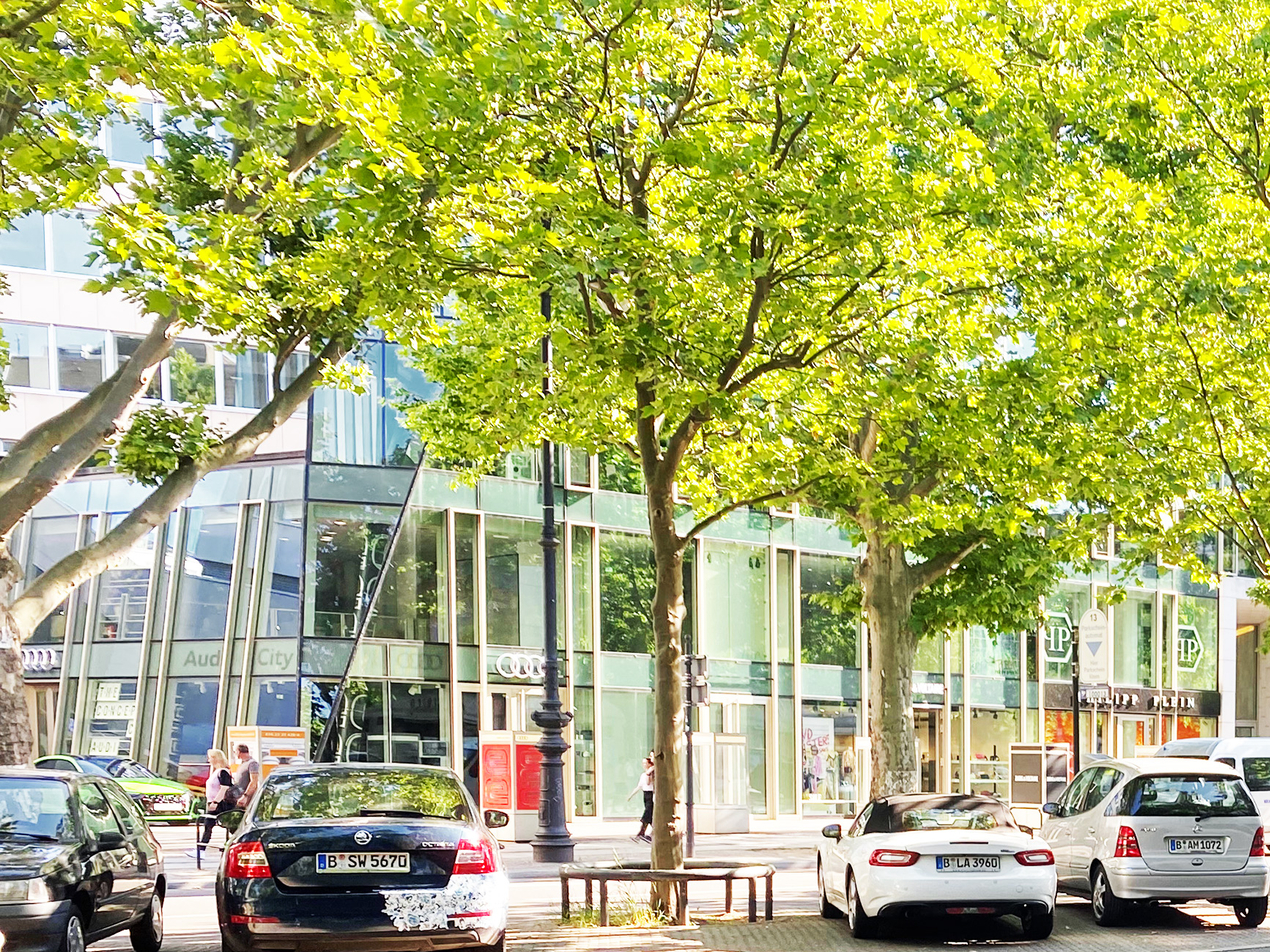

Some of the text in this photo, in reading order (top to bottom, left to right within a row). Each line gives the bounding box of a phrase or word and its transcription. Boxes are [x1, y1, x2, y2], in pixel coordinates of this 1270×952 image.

[1090, 614, 1097, 622] 13
[183, 649, 294, 669] Aud City
[1153, 694, 1195, 708] PLEIN
[1176, 840, 1182, 850] B
[328, 854, 337, 868] B
[348, 854, 367, 868] SW
[370, 854, 407, 868] 5670
[943, 858, 999, 868] B LA 3960
